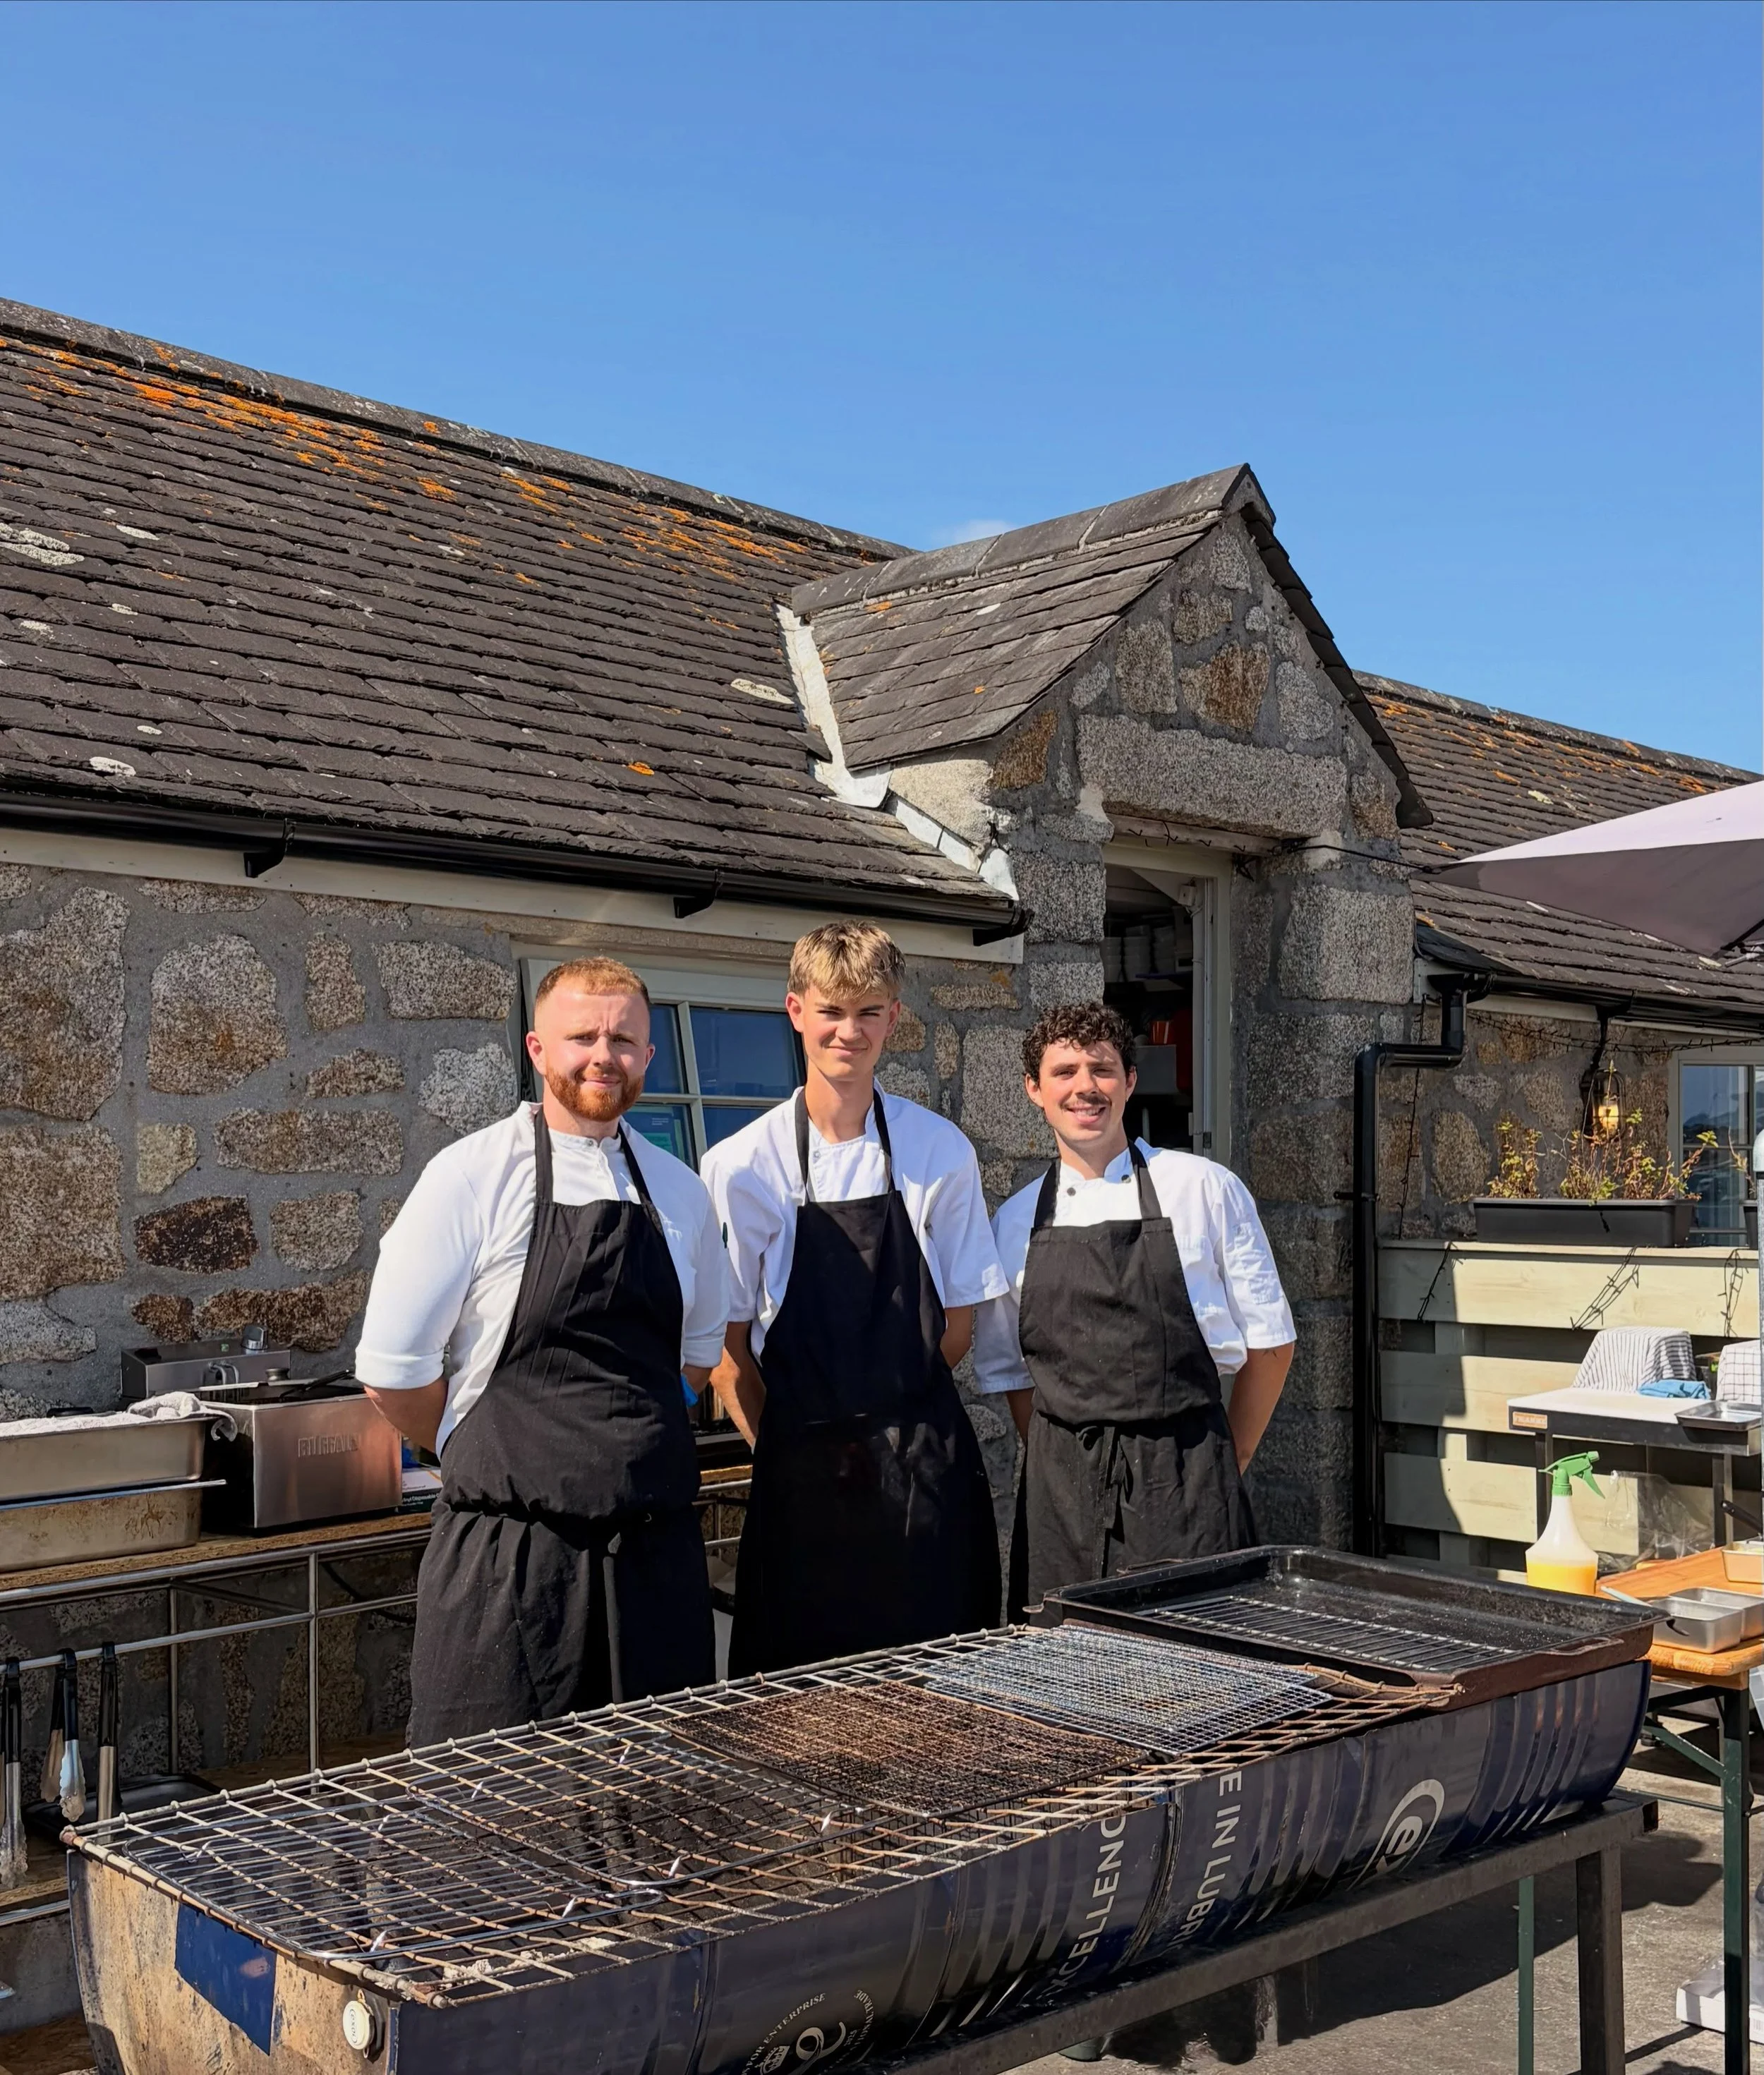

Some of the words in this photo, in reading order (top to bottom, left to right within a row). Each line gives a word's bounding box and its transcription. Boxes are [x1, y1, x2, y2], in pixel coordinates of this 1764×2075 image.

[1219, 1771, 1242, 1796] E
[1212, 1804, 1241, 1849] IN
[763, 1993, 826, 2044] ENTERPRISE
